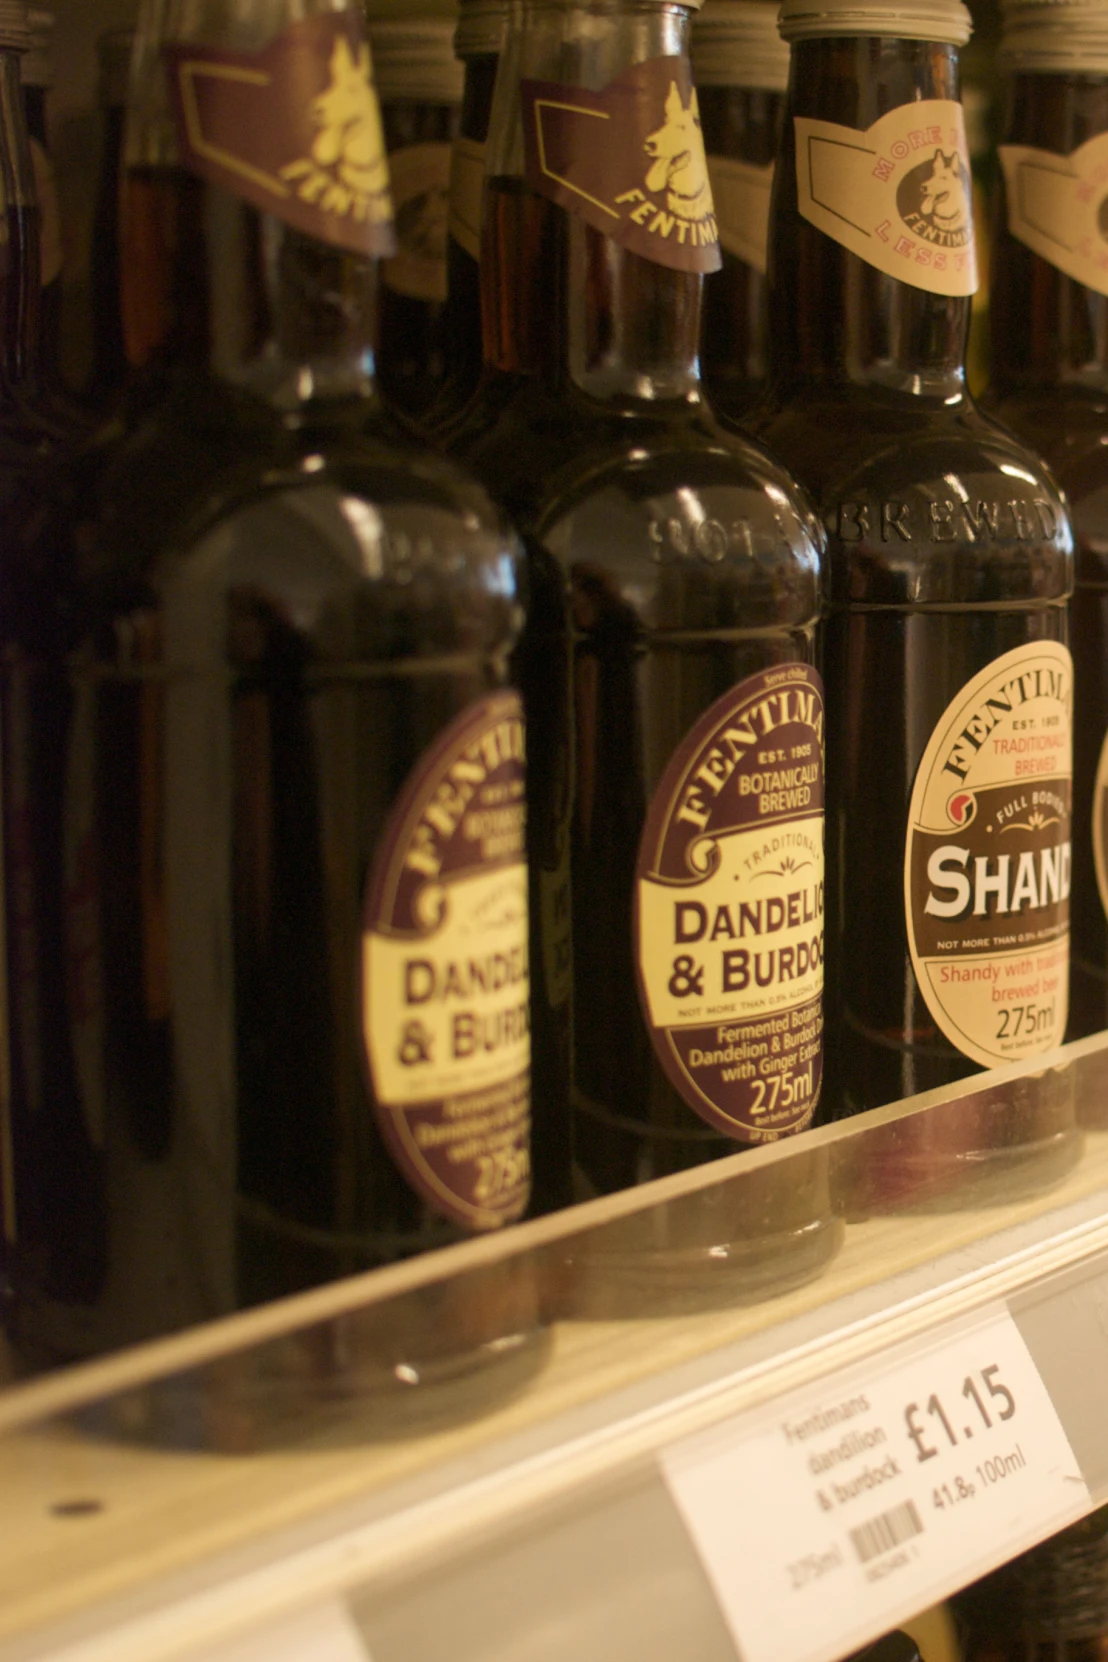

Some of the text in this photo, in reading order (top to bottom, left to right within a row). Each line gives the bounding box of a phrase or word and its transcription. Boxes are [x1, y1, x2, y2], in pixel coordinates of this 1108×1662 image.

[872, 126, 942, 182] MORE
[874, 219, 948, 271] LESS
[1012, 719, 1037, 731] EST.
[758, 750, 788, 764] EST.
[1014, 756, 1058, 776] BREWED
[759, 786, 812, 815] BREWED
[995, 796, 1029, 824] FULL
[937, 940, 958, 950] NOT
[962, 938, 990, 949] MORE
[993, 936, 1017, 946] THAN
[668, 954, 705, 998] &
[940, 962, 1001, 984] Shandy
[1004, 958, 1034, 978] with
[992, 978, 1040, 1003] brewed
[678, 1008, 702, 1018] NOT
[706, 1003, 737, 1014] MORE
[741, 998, 766, 1010] THAN
[995, 995, 1056, 1040] 275ml
[396, 1020, 432, 1066] &
[717, 1013, 789, 1044] Fermented
[689, 1041, 768, 1068] Dandelion
[771, 1036, 781, 1053] &
[722, 1061, 756, 1082] with
[759, 1052, 797, 1074] Ginger
[750, 1061, 813, 1115] 275ml
[903, 1363, 1016, 1463] £1.15
[831, 1453, 902, 1504] burdock
[975, 1443, 1028, 1488] 100ml
